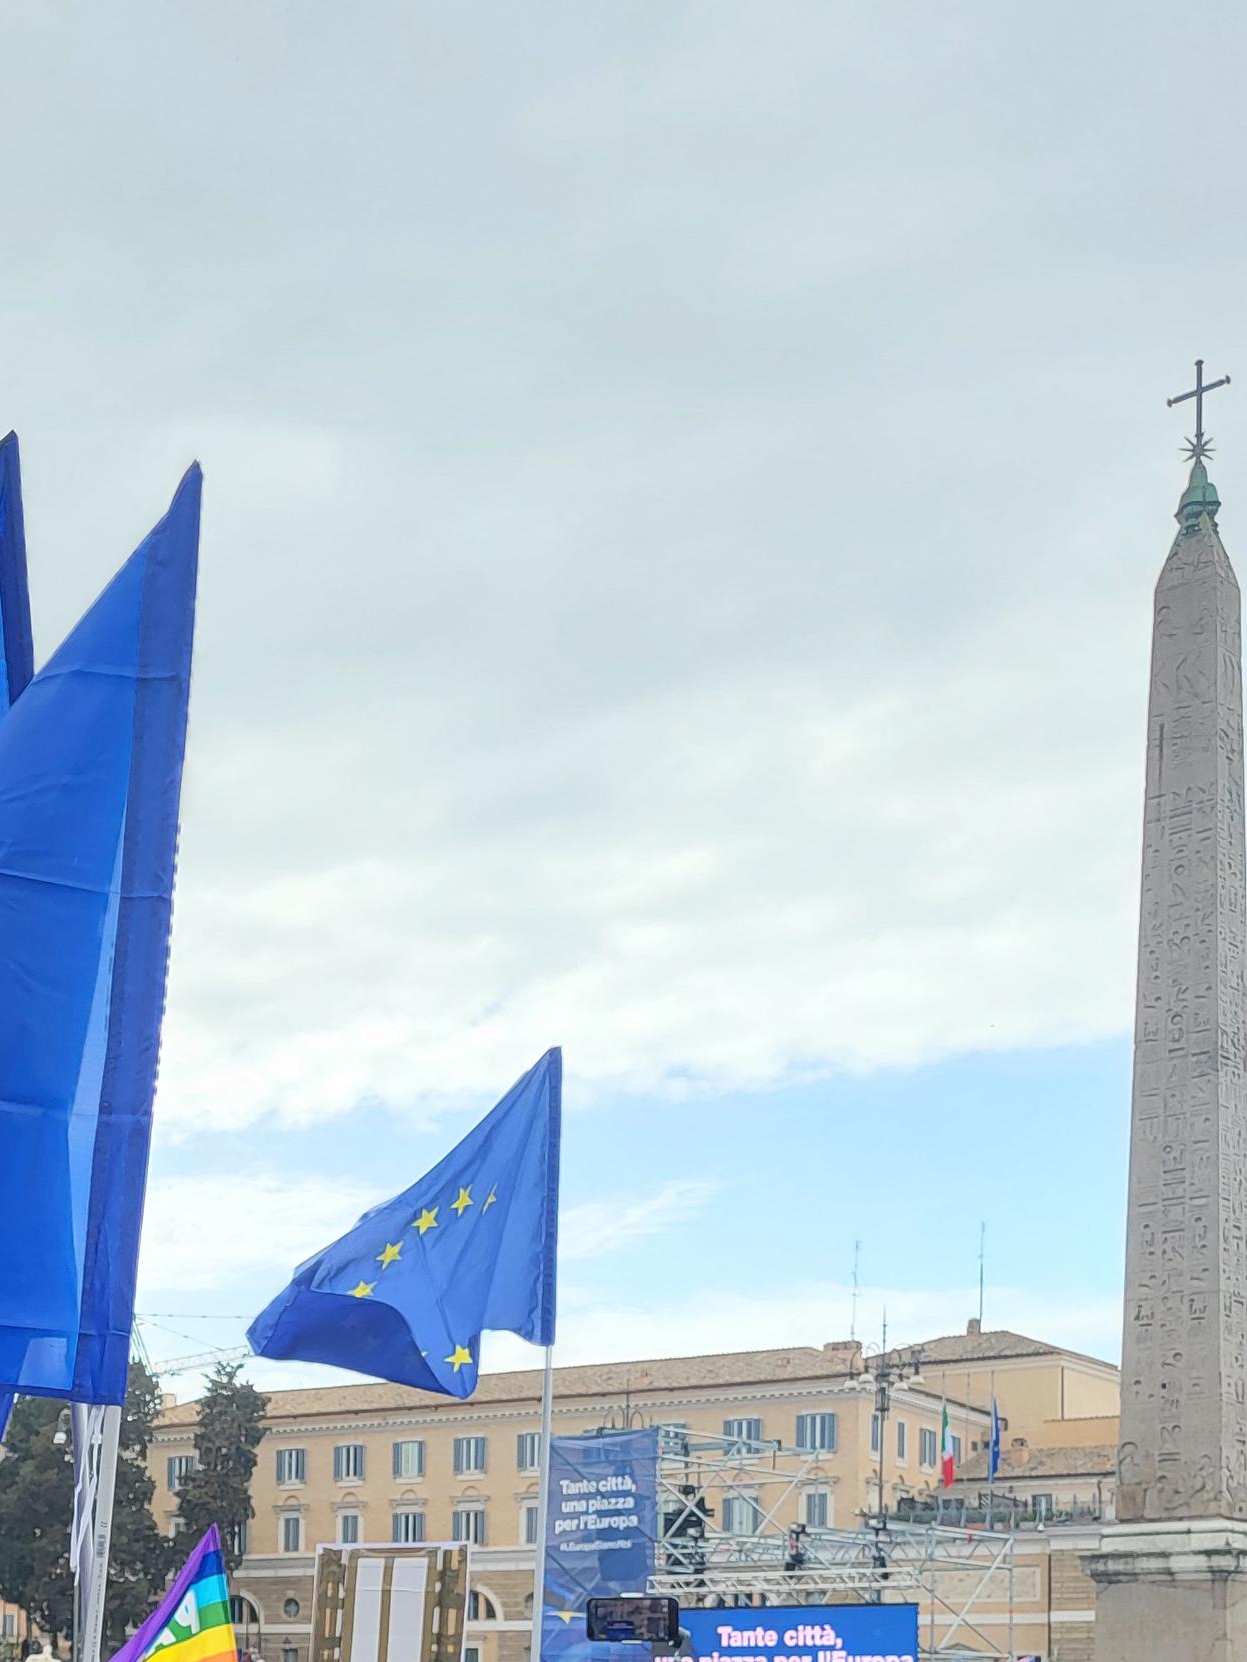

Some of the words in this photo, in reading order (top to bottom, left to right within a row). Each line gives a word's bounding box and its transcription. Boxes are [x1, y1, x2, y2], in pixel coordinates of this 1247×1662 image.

[559, 1479, 597, 1495] Tante
[598, 1475, 636, 1493] città,
[561, 1499, 587, 1513] una
[588, 1495, 635, 1513] piazza
[554, 1518, 579, 1534] per
[580, 1514, 639, 1531] l'Europa
[716, 1626, 778, 1647] Tante
[783, 1625, 843, 1649] città,
